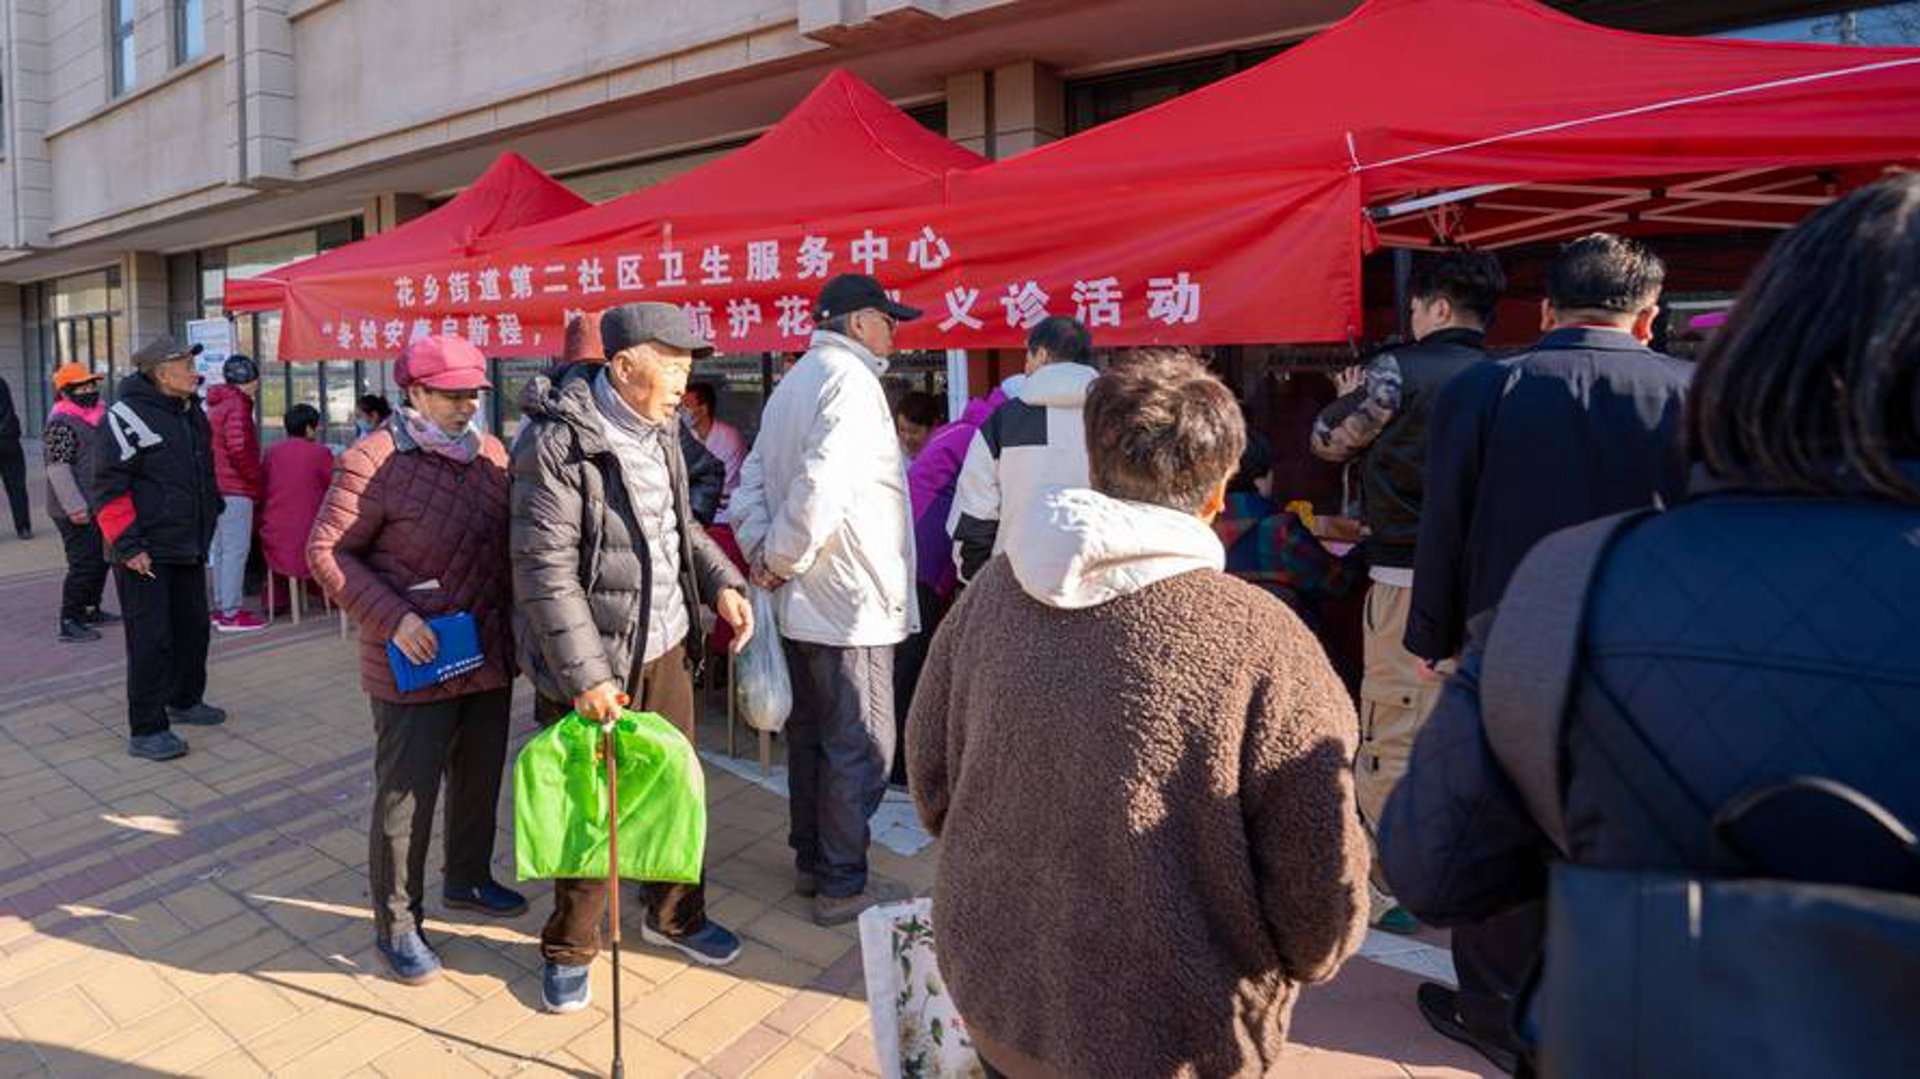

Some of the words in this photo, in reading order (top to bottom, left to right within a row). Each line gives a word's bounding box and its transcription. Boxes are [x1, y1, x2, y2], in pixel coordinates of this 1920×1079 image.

[395, 226, 951, 307] 花乡街道第二社区卫生服务中心
[108, 401, 162, 461] A
